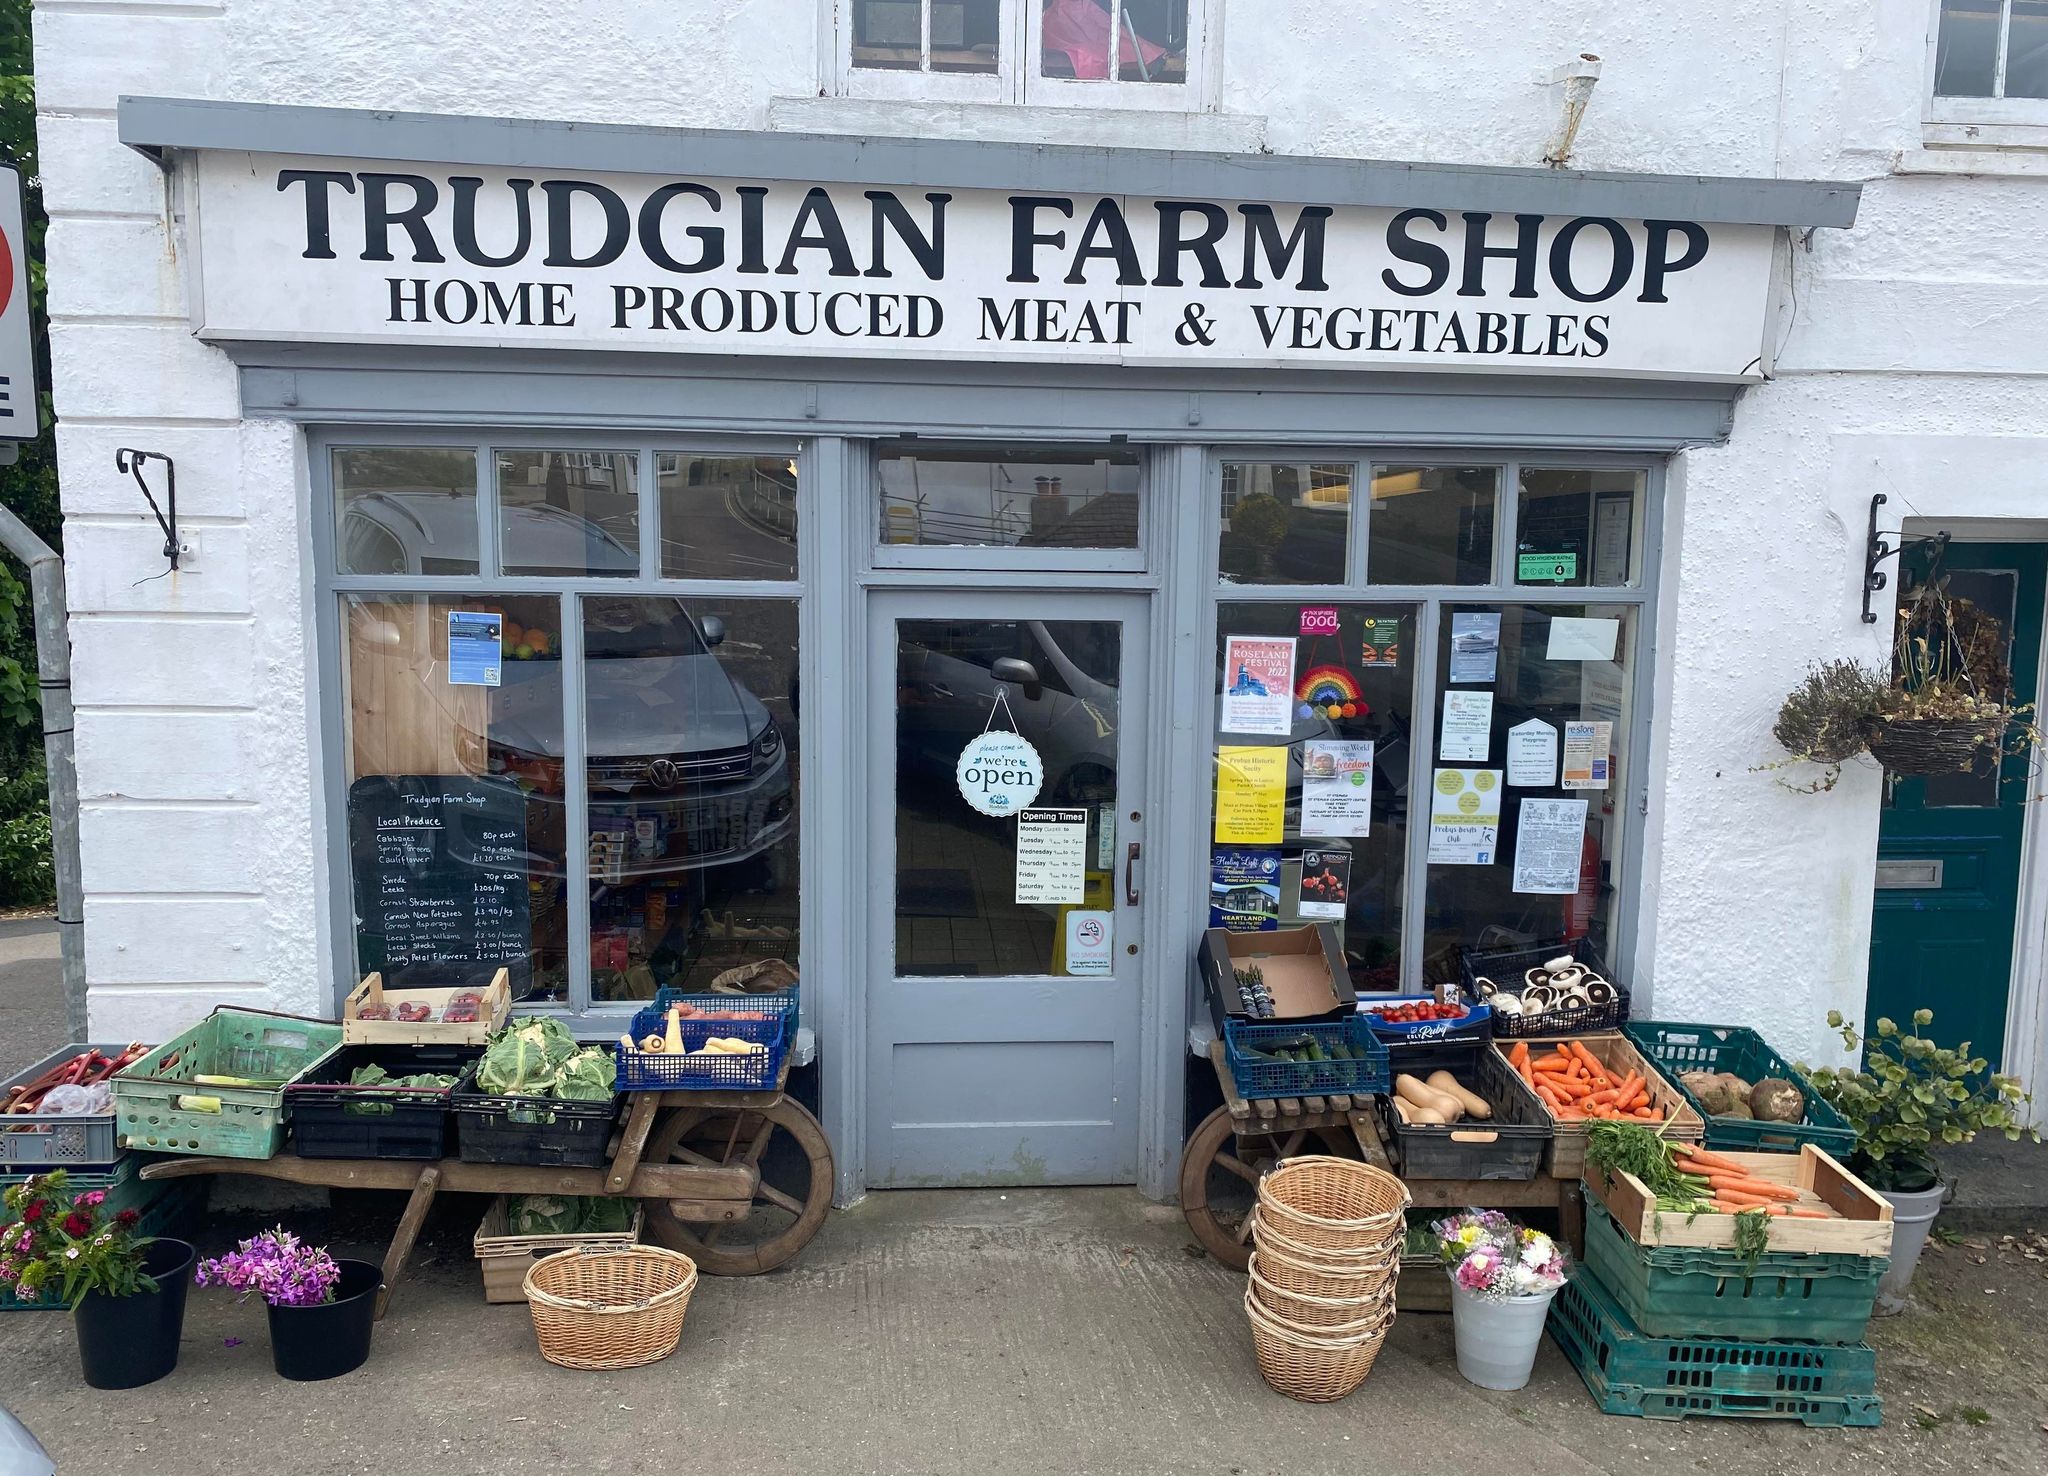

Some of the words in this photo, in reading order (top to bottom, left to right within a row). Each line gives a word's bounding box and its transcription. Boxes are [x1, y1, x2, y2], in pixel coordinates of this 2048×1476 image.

[277, 169, 952, 281] TRUDGIAN
[1006, 196, 1334, 291] FARM
[1381, 207, 1709, 303] SHOP
[384, 277, 577, 327] HOME
[610, 285, 944, 338] PRODUCED
[977, 296, 1142, 344] MEAT
[1174, 302, 1218, 346] &
[1250, 305, 1611, 358] VEGETABLES
[1556, 566, 1563, 574] 4
[1301, 611, 1337, 627] food
[1233, 649, 1289, 659] ROSELAND
[1245, 658, 1288, 667] FESTIVAL
[1267, 667, 1288, 676] 2022
[980, 744, 998, 752] please
[1319, 744, 1350, 752] Slimming
[1351, 744, 1371, 752] World
[984, 755, 1018, 767] we're
[1336, 758, 1371, 775] freedom
[965, 768, 1035, 793] open
[401, 793, 440, 808] Trudgian
[443, 793, 463, 804] Farm
[466, 792, 486, 807] Shop
[378, 816, 400, 826] Local
[405, 816, 441, 826] Produce
[1022, 812, 1056, 822] Opening
[1058, 812, 1083, 821] Times
[377, 834, 415, 846] Cabbages
[483, 832, 498, 842] 80p
[378, 845, 402, 857] Spring
[406, 844, 431, 853] Greens
[379, 856, 430, 864] Cauliflower
[1216, 856, 1239, 868] Healing
[382, 875, 407, 884] Swede
[484, 873, 499, 882] 70p
[380, 899, 407, 907] Cornish
[409, 897, 455, 907] Strawberries
[384, 912, 410, 921] Cornish
[430, 909, 462, 918] Potatoes
[1221, 914, 1267, 922] HEARTLANDS
[384, 921, 411, 930] Cornish
[416, 920, 456, 930] Asparagus
[432, 932, 461, 940] Williams
[386, 953, 408, 966] Pretty
[411, 953, 430, 962] Petal
[1081, 951, 1110, 959] SMOKING
[1419, 1024, 1448, 1040] Ruby
